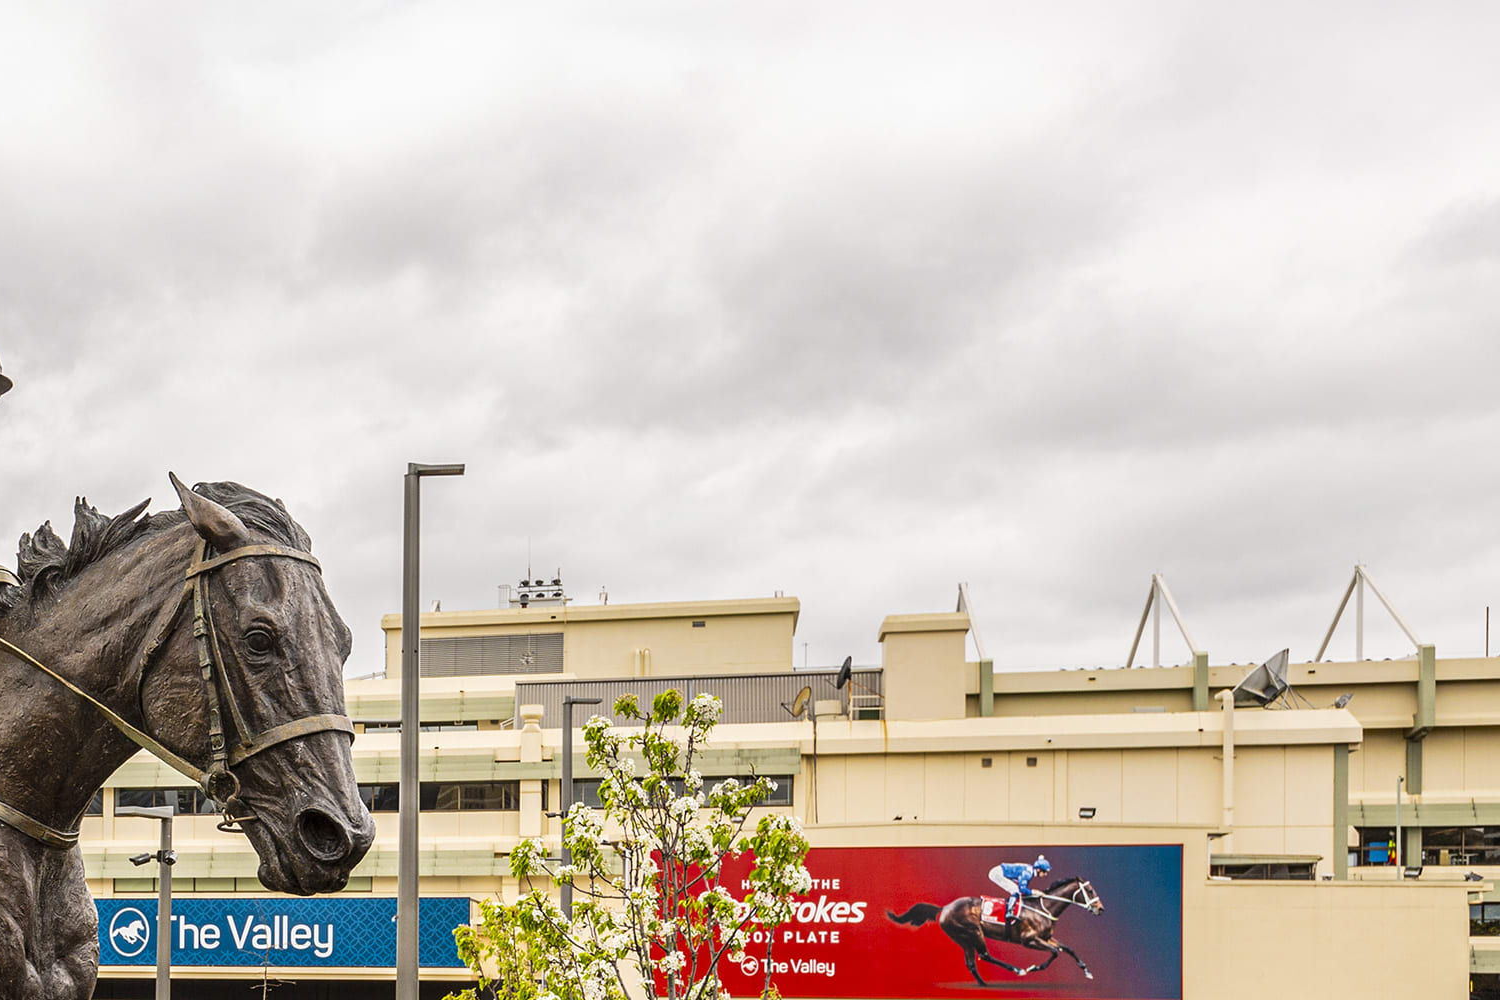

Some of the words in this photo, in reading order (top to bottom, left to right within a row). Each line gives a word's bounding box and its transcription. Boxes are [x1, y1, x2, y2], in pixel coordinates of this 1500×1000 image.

[812, 879, 840, 889] THE
[226, 915, 334, 958] Valley
[783, 931, 840, 943] PLATE
[760, 959, 788, 973] The
[790, 959, 835, 977] Valley
